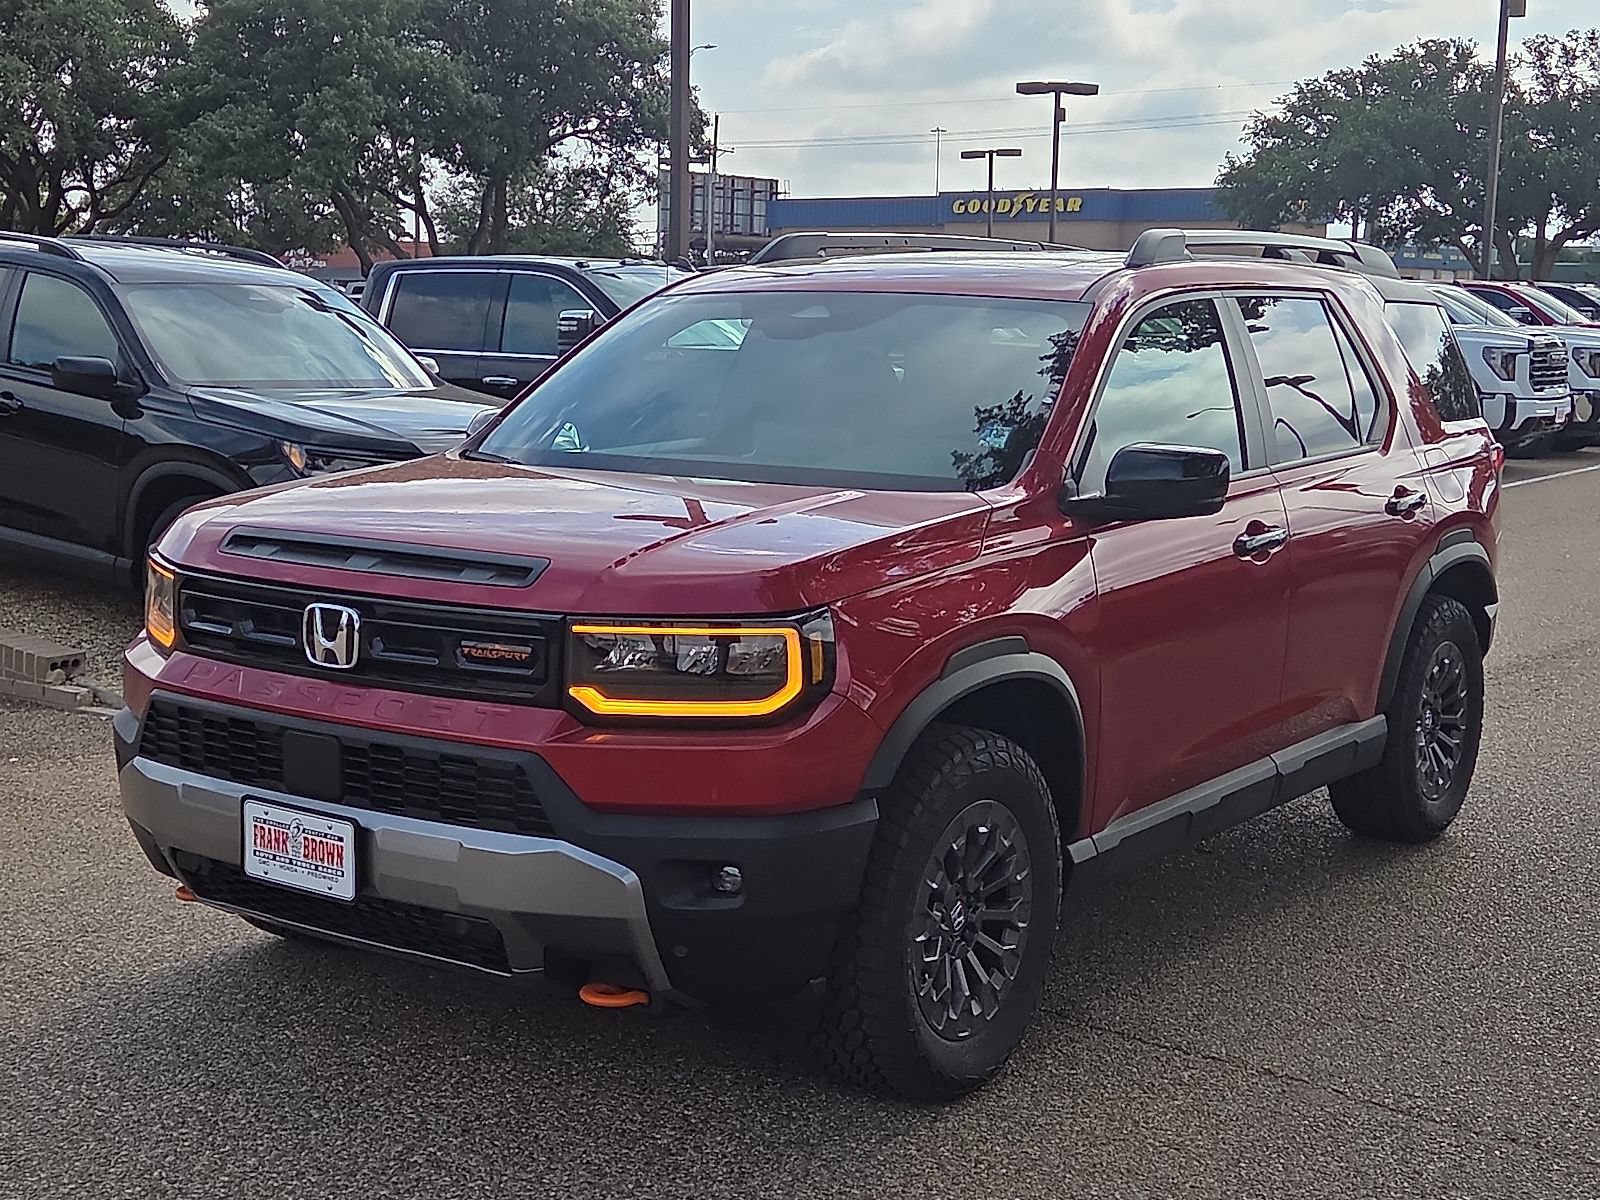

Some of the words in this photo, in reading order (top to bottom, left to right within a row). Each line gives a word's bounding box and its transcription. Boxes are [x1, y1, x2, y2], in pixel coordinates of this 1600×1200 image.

[952, 196, 1082, 215] GOODYEAR
[462, 647, 529, 660] TRAILSPORT
[183, 661, 512, 729] PASSPORT
[253, 823, 290, 855] FRANK
[302, 836, 344, 869] BROWN
